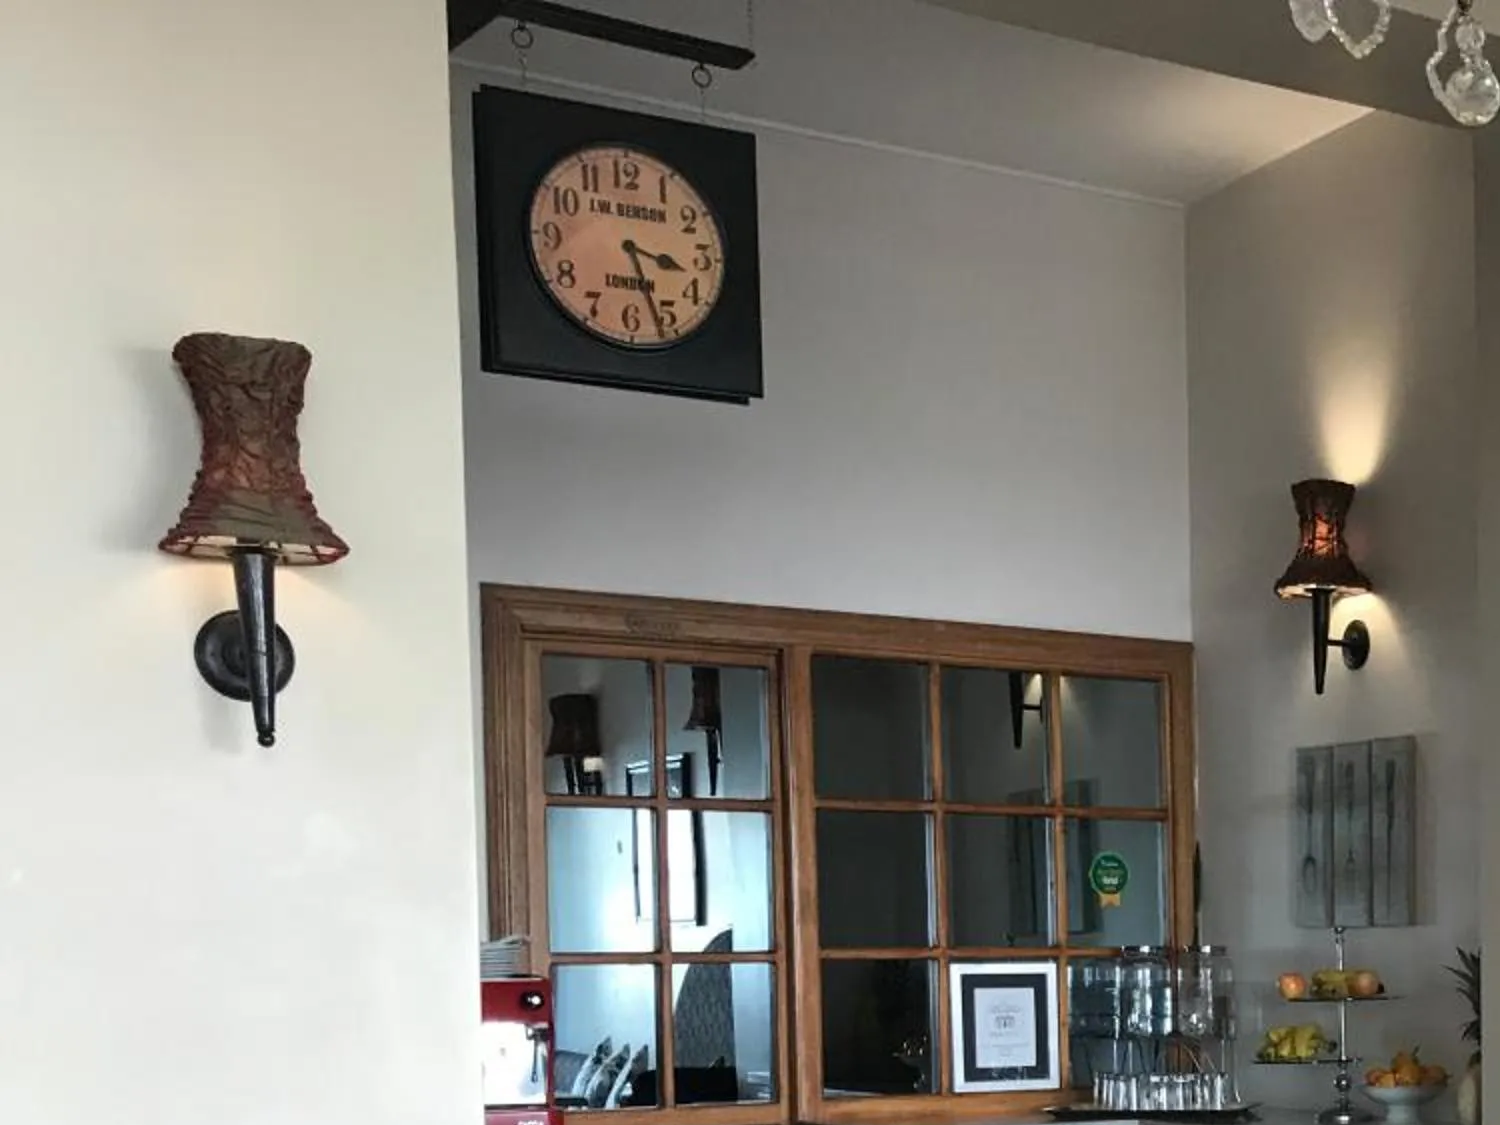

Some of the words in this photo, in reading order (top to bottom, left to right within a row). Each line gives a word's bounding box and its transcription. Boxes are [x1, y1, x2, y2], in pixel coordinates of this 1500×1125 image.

[581, 163, 599, 193] 11
[613, 159, 640, 191] 12
[658, 175, 667, 204] 1
[553, 187, 579, 217] 10
[680, 205, 697, 234] 2
[542, 222, 562, 250] 9
[693, 244, 712, 271] 3
[557, 259, 576, 288] 8
[584, 291, 602, 318] 7
[682, 277, 699, 306] 4
[622, 303, 640, 333] 6
[659, 300, 677, 329] 5
